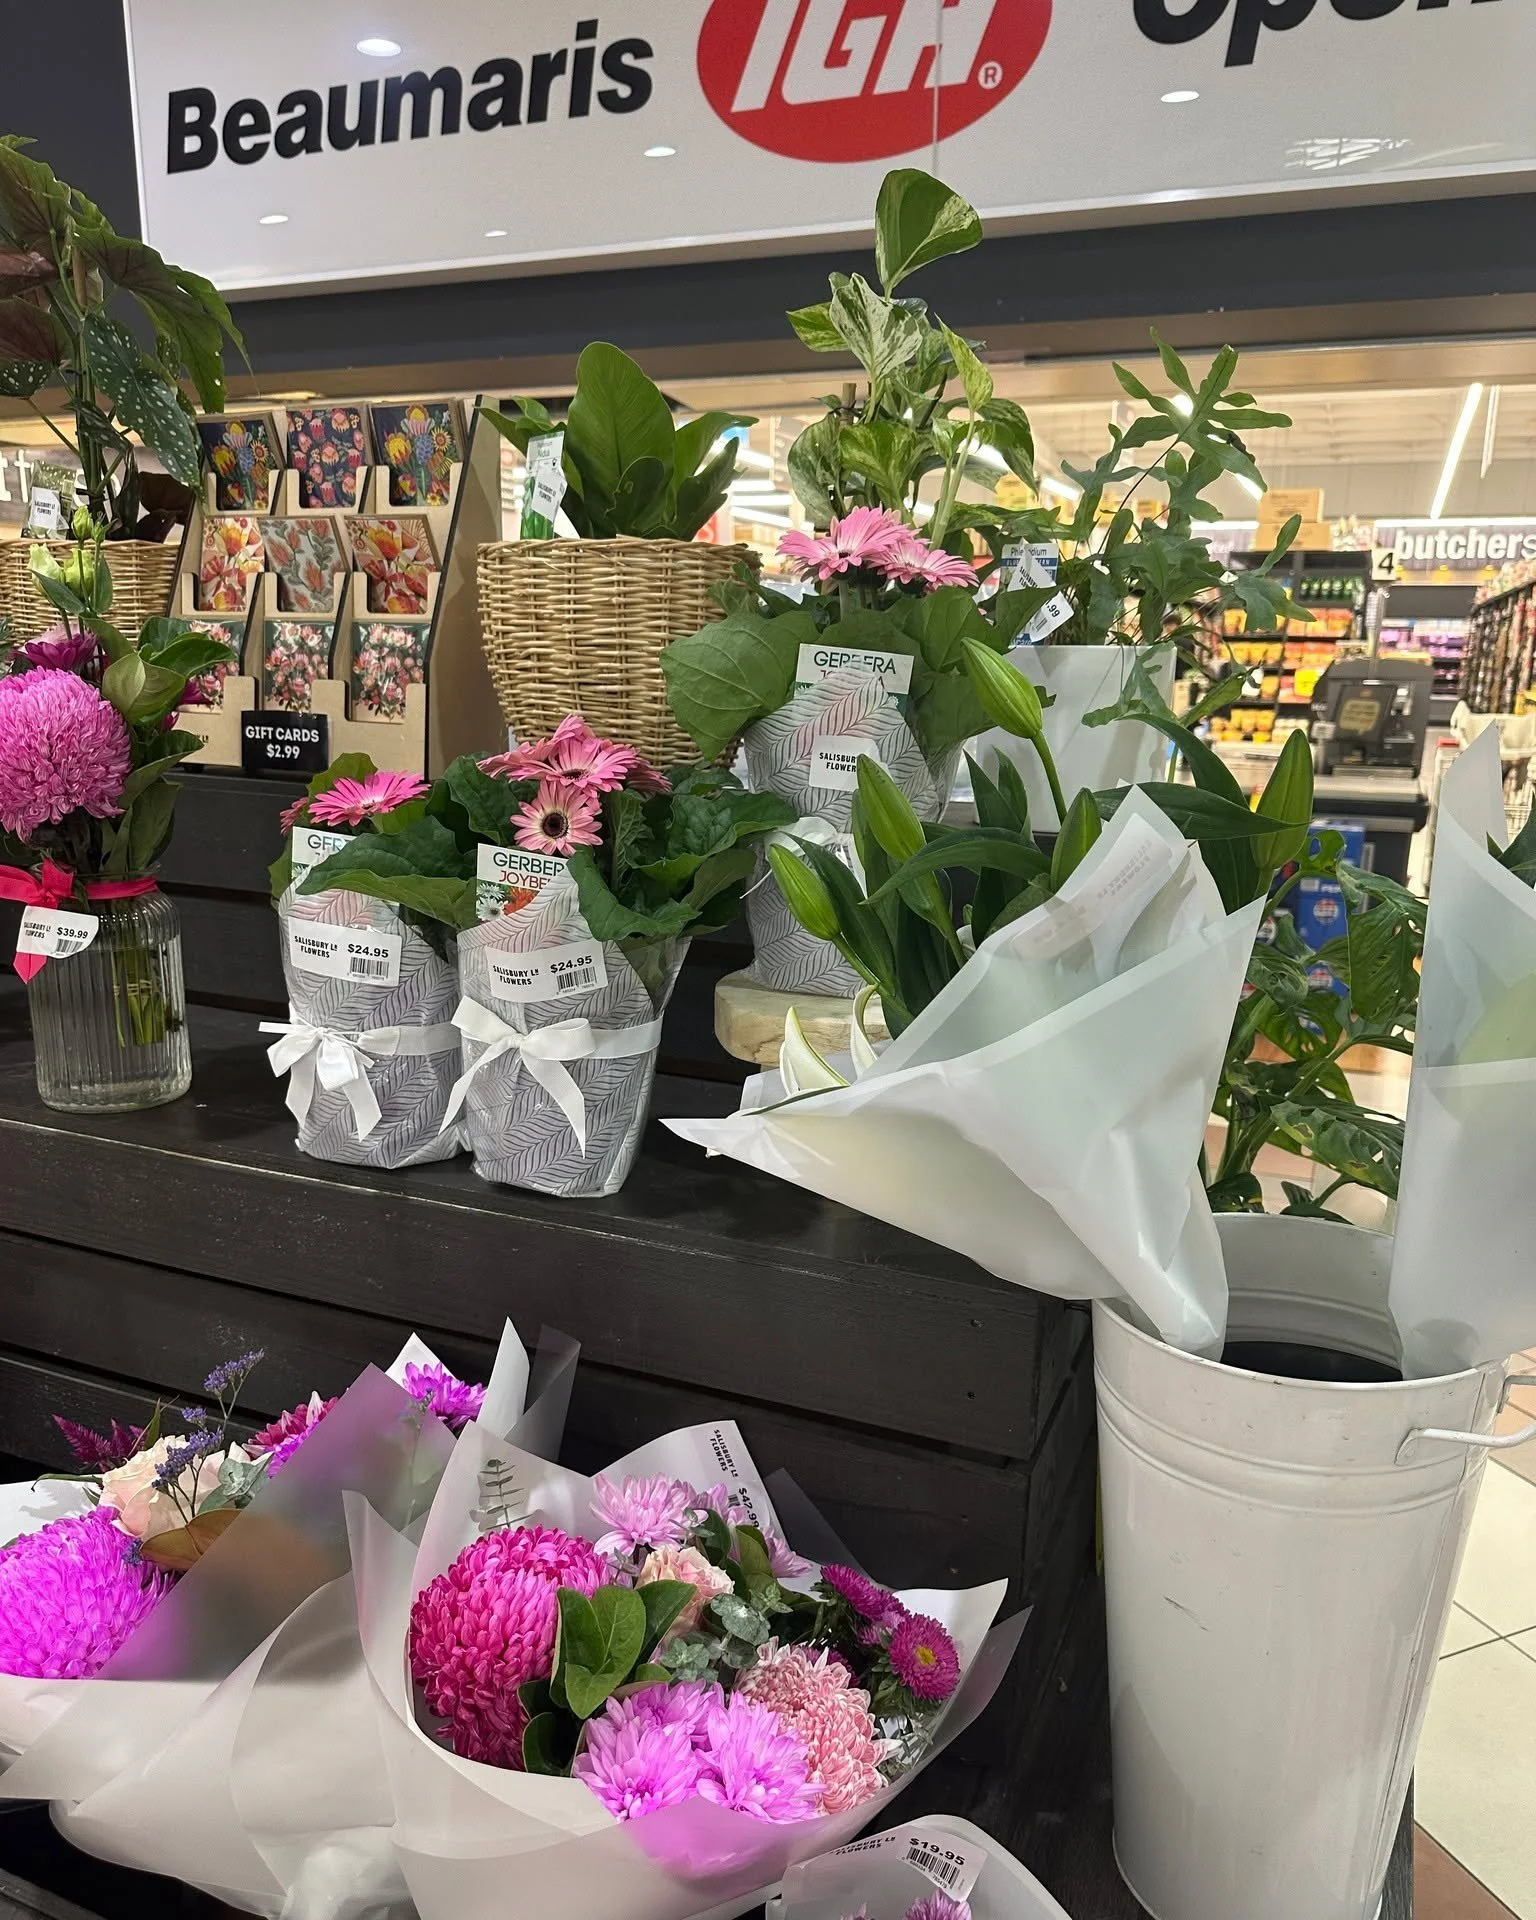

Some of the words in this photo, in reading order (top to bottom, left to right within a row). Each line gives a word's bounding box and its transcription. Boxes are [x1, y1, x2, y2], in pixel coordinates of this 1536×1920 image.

[730, 0, 997, 113] IGA
[167, 19, 655, 176] Beaumaris
[1395, 527, 1536, 560] butchers
[1378, 552, 1394, 575] 4
[245, 725, 274, 740] GIFT
[275, 728, 320, 743] CARDS
[266, 743, 301, 759] $2.99
[819, 752, 857, 764] SALISBUR
[825, 761, 857, 773] FLOWER
[56, 926, 89, 939] $39.99
[294, 935, 329, 950] SALISBURY
[347, 943, 389, 959] $24.95
[300, 945, 330, 959] FLOWERS
[492, 965, 530, 978] SALISBURY
[550, 955, 593, 975] $24.95
[499, 975, 533, 986] FLOWERS
[709, 1437, 729, 1472] FLOWERS
[713, 1428, 735, 1468] SALISBURY
[738, 1486, 760, 1528] $47.99
[909, 1837, 966, 1866] $19.95
